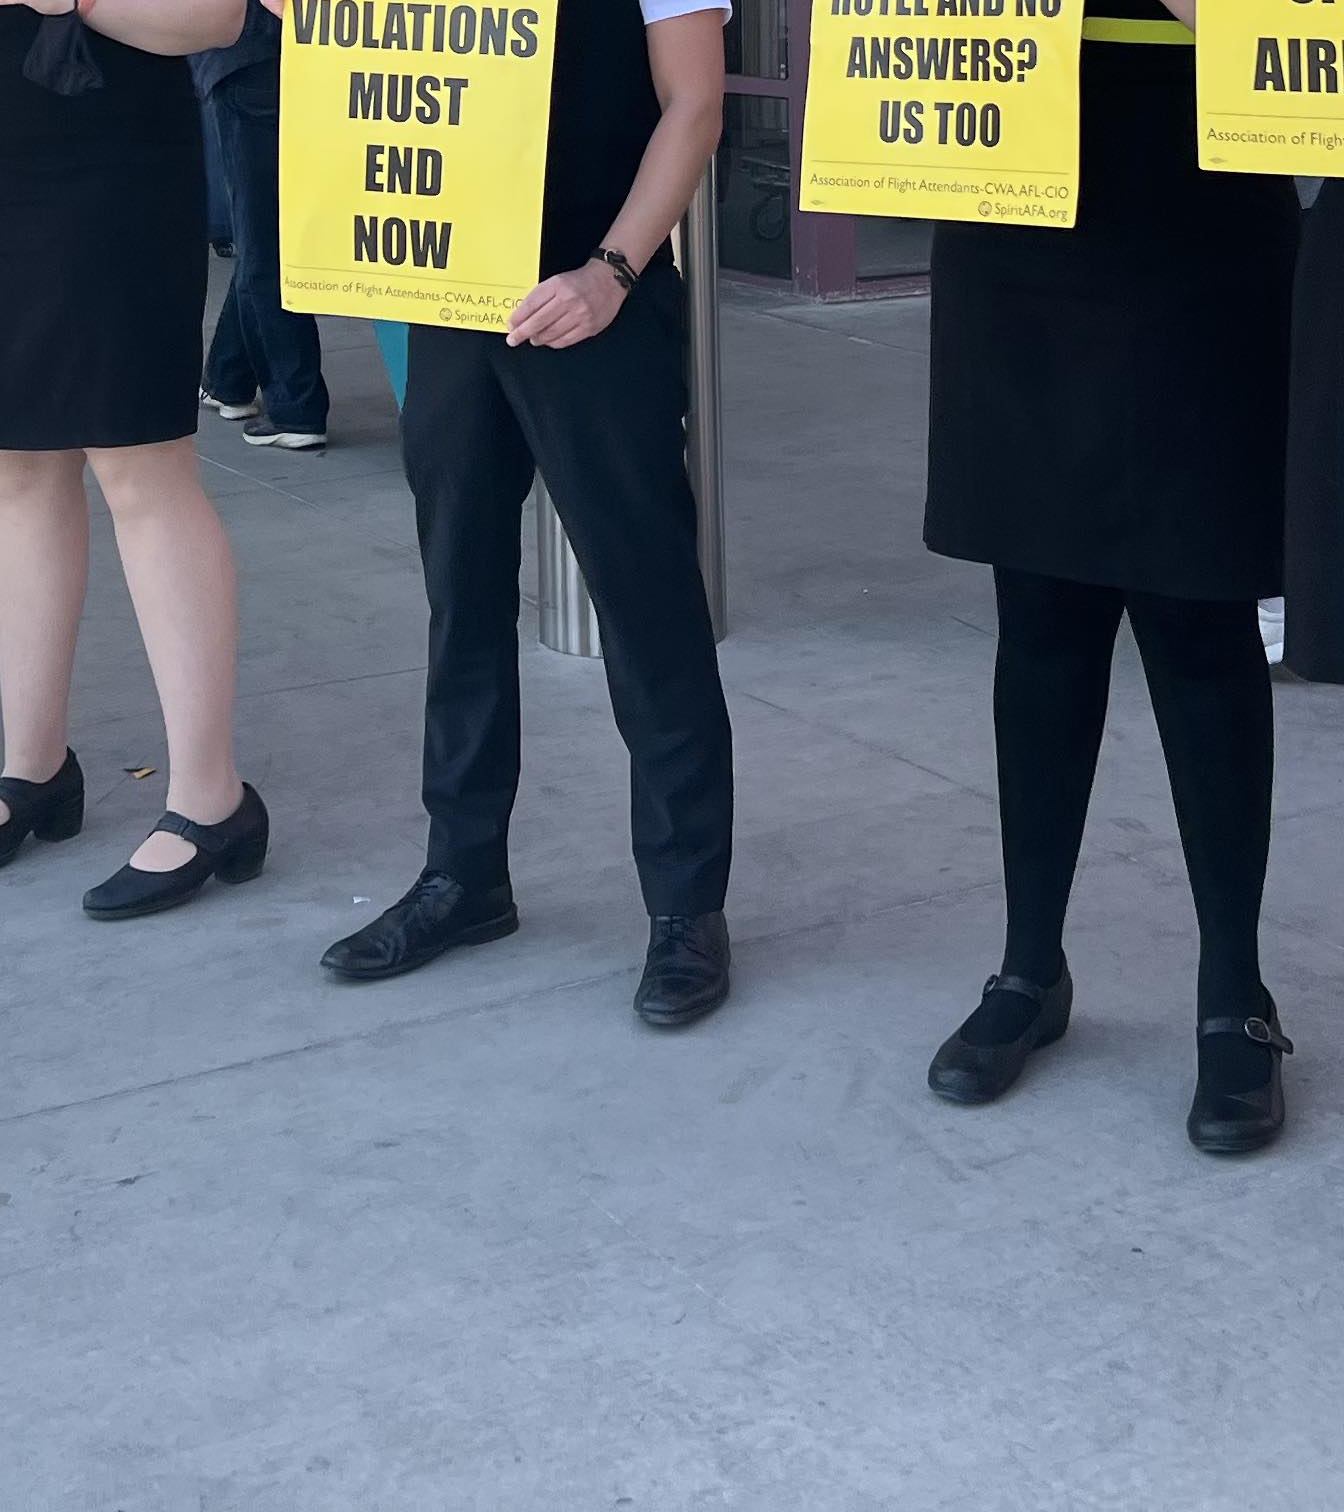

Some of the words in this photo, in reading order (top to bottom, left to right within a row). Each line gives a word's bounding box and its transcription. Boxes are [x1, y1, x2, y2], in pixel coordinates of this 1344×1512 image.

[846, 36, 1038, 83] ANSWERS?
[348, 71, 469, 126] MUST
[879, 100, 925, 145] US
[934, 102, 1001, 147] TOO
[1207, 127, 1286, 146] Association
[1291, 132, 1306, 145] of
[365, 143, 443, 197] END
[810, 173, 870, 188] Association
[873, 176, 886, 188] of
[888, 177, 916, 193] Flight
[1019, 185, 1069, 199] AFL-CIO
[994, 202, 1068, 222] SpiritAFA.org
[353, 214, 452, 270] NOW
[342, 282, 354, 293] of
[355, 284, 382, 299] Flight
